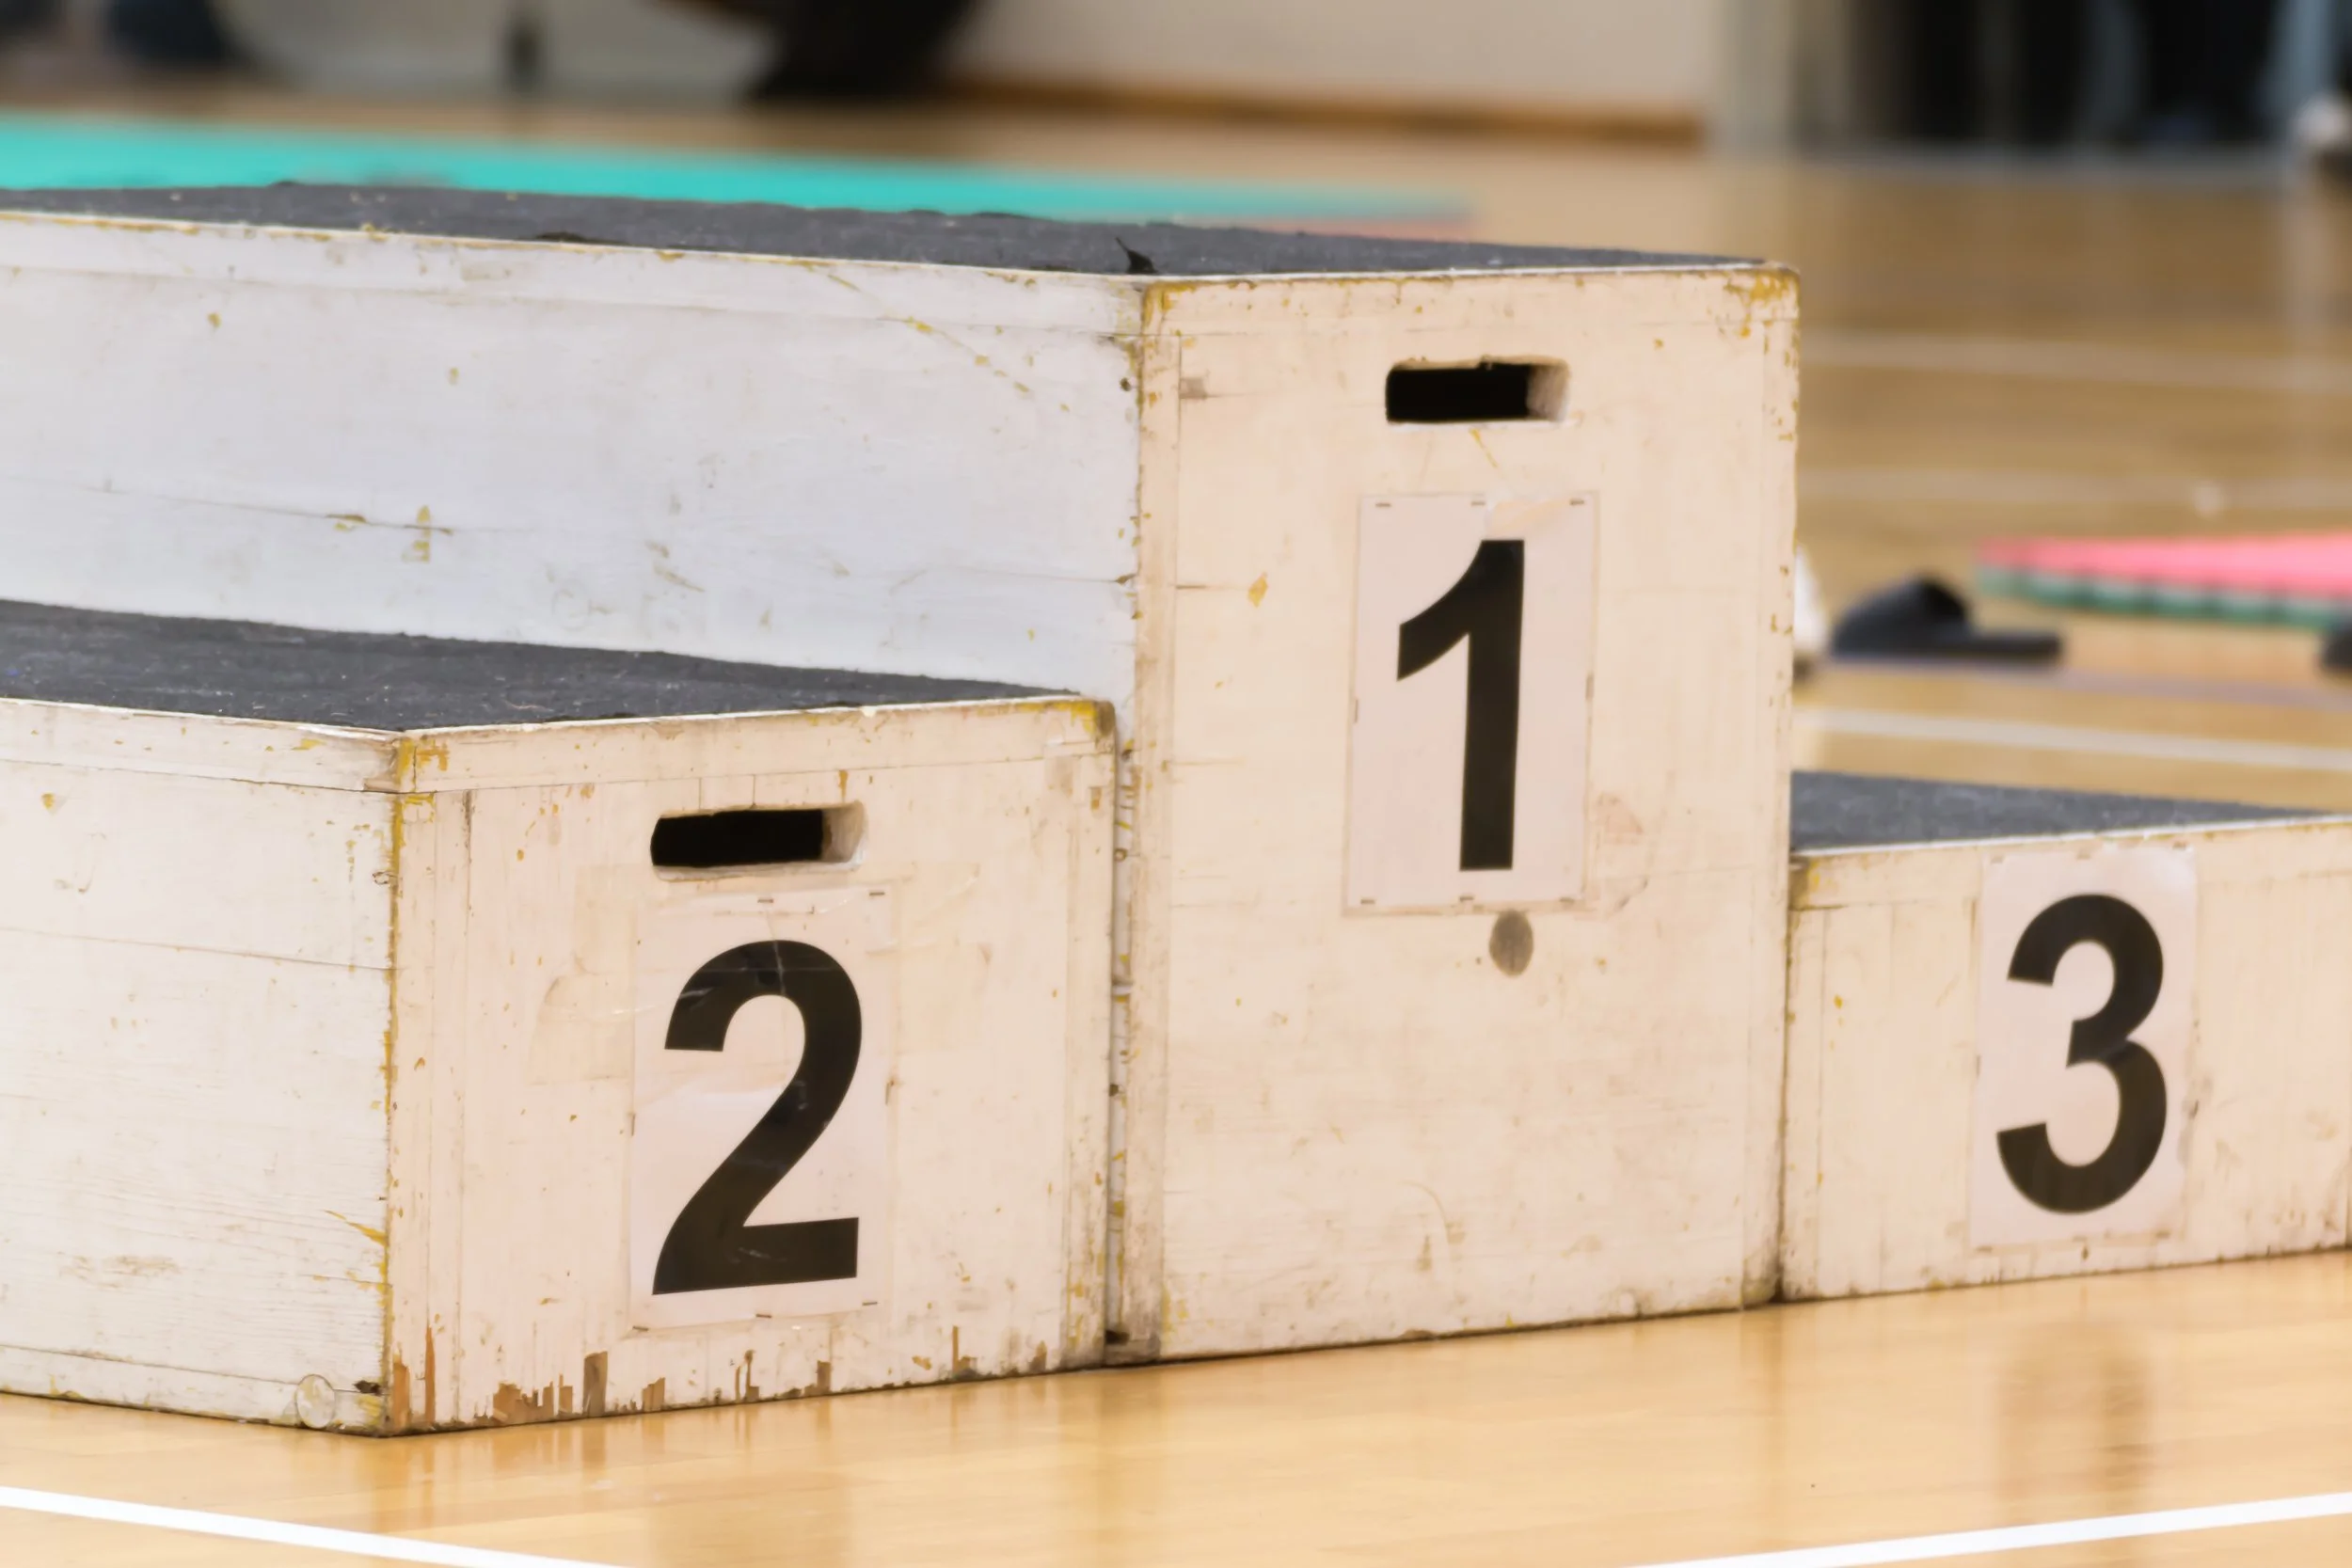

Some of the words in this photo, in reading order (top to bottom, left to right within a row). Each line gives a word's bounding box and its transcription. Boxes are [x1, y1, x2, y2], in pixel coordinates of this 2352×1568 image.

[1397, 539, 1525, 871] 1
[652, 940, 863, 1295] 2
[1996, 893, 2168, 1214] 3
